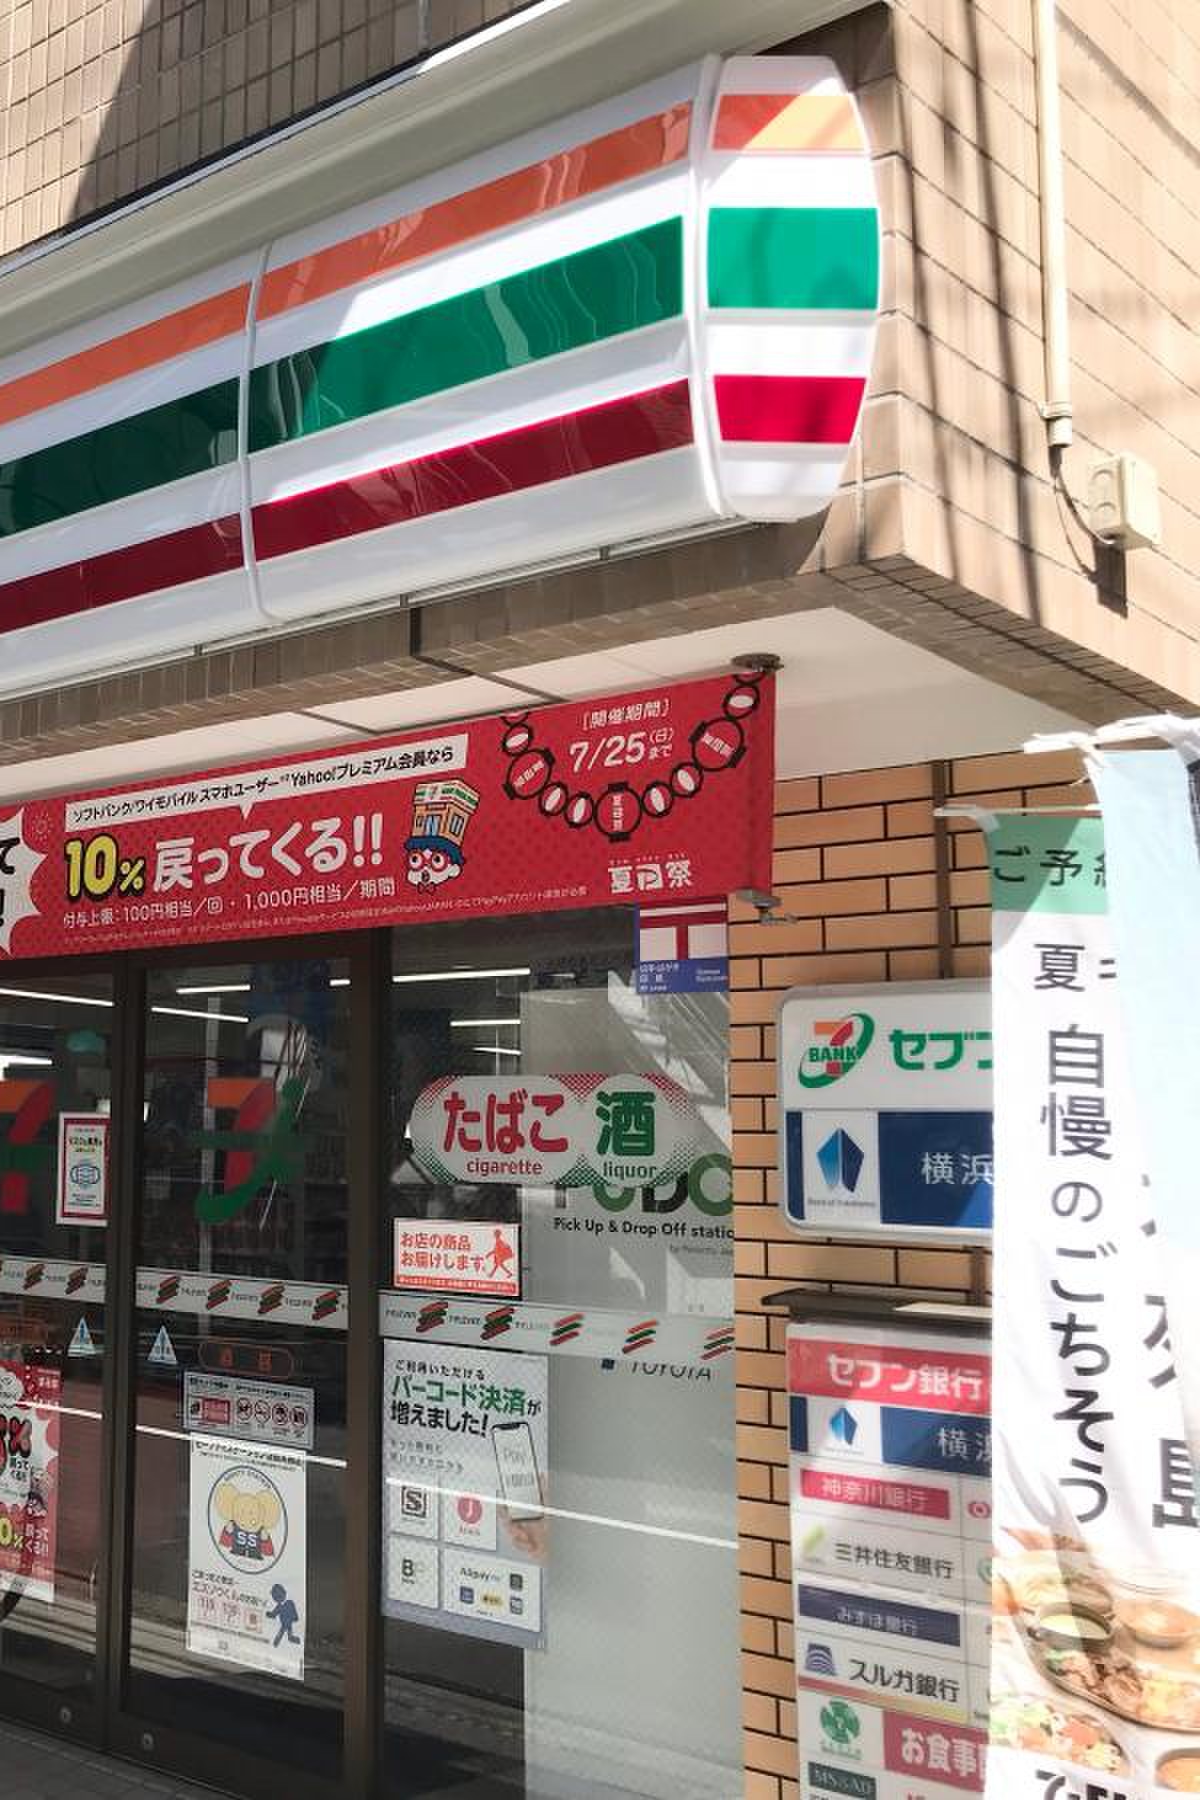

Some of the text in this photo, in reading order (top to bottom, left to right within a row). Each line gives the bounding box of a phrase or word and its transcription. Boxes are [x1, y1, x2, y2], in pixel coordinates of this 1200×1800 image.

[569, 731, 647, 773] 7/25
[65, 833, 146, 901] 10%
[443, 1088, 656, 1157] たばこ 酒
[466, 1157, 656, 1180] cigarette liquor
[400, 1232, 470, 1252] お店の商品
[553, 1217, 580, 1232] Pick
[585, 1218, 604, 1235] Up
[609, 1220, 618, 1233] &
[622, 1221, 657, 1238] Drop
[661, 1222, 687, 1236] Off
[1040, 1023, 1118, 1524] 自慢のごちそう
[391, 1375, 541, 1416] バーコード決済が
[827, 1353, 984, 1400] セブン銀行
[390, 1400, 489, 1437] 増えました!
[236, 1531, 258, 1548] SS
[835, 1542, 953, 1580] 三井住友銀行
[849, 1658, 960, 1703] スルガ銀行
